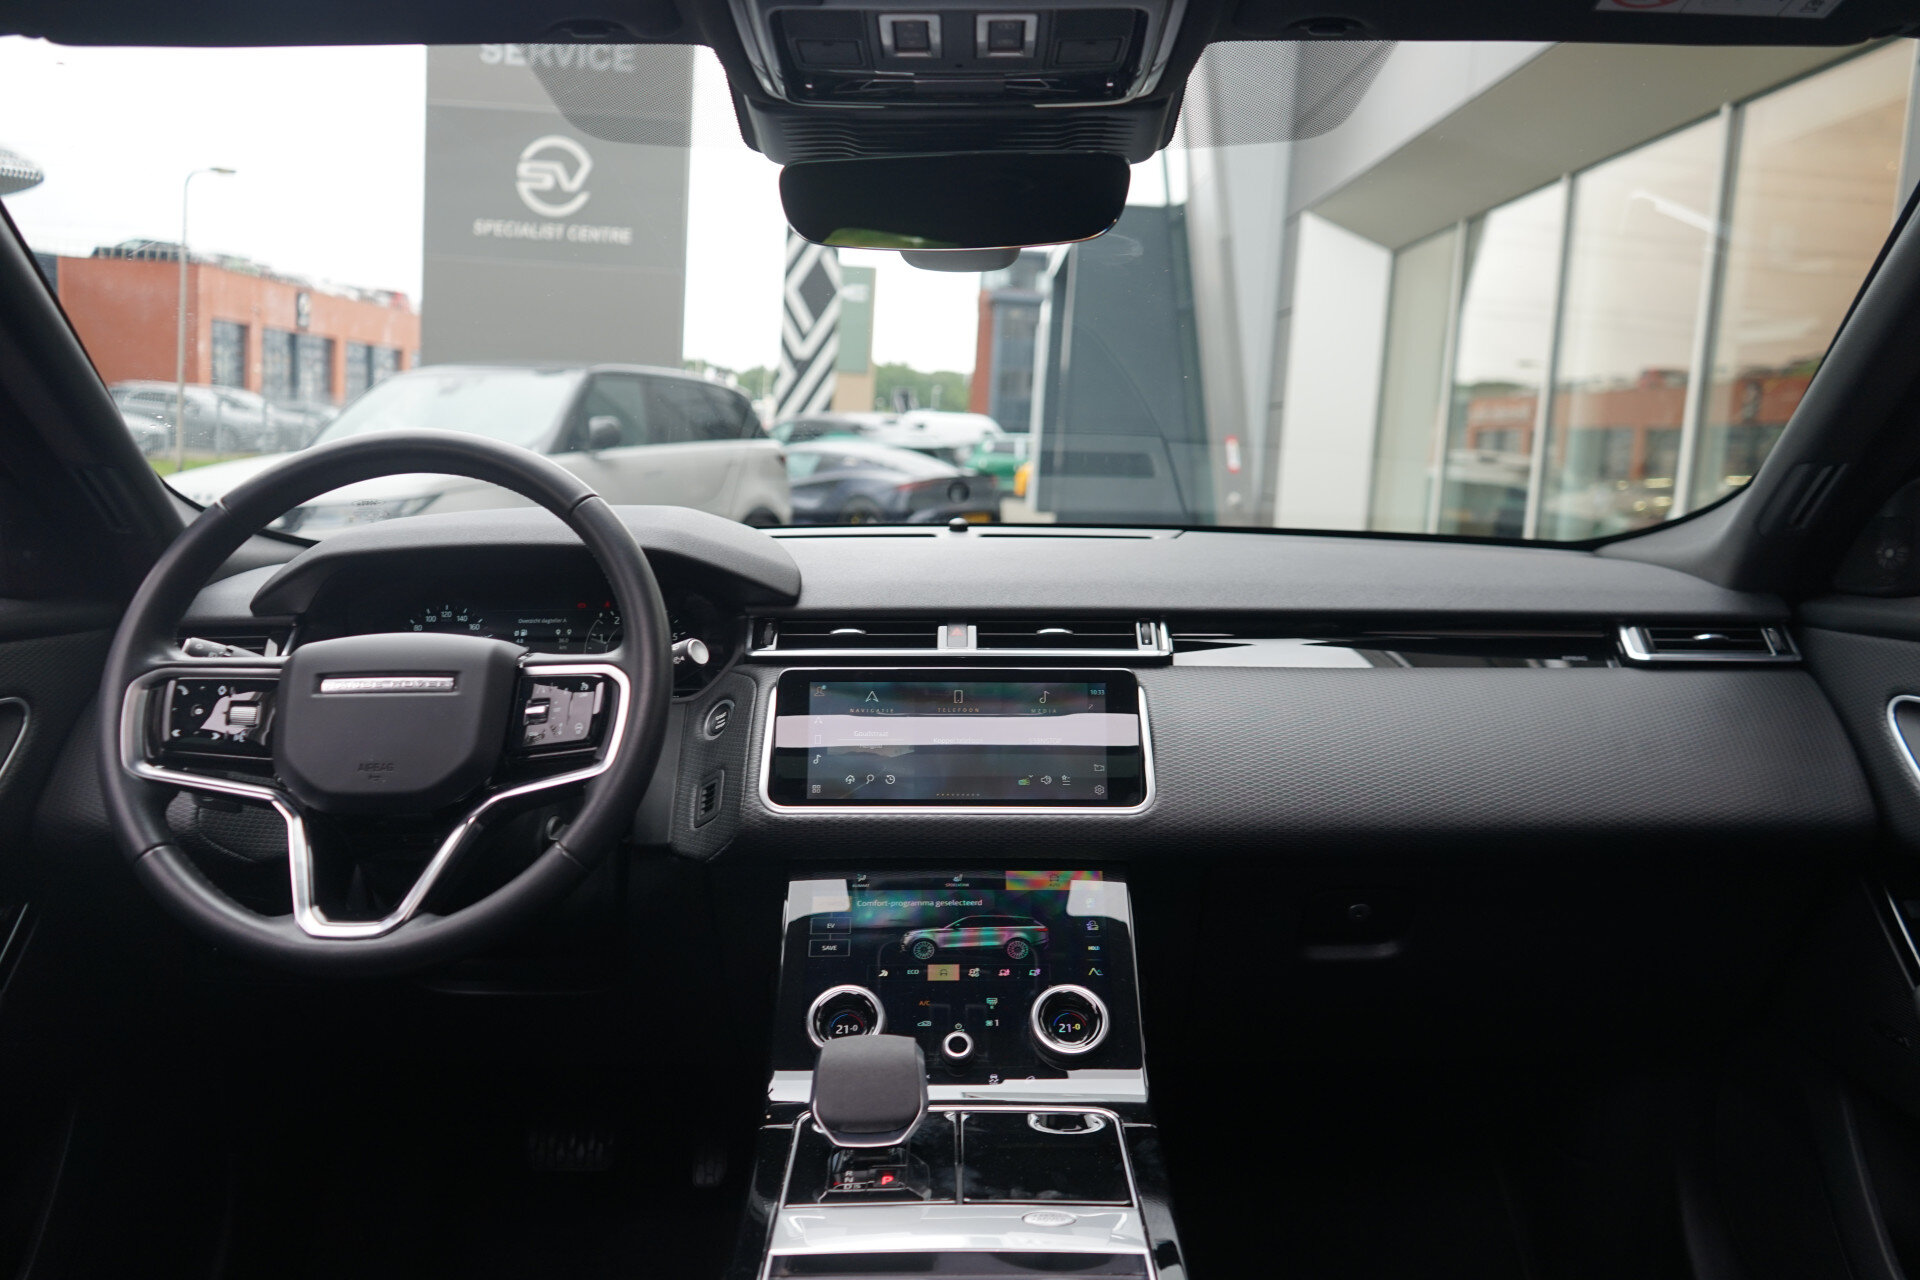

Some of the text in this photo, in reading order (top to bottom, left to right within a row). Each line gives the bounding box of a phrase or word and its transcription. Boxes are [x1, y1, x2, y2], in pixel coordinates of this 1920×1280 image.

[480, 44, 636, 73] SERVICE
[472, 218, 633, 246] SPECIALIST CENTRE
[614, 617, 620, 625] 2
[413, 624, 423, 632] 80
[469, 623, 480, 631] 160
[856, 898, 983, 909] Comfort-programma geselecteerd
[881, 1175, 894, 1185] P
